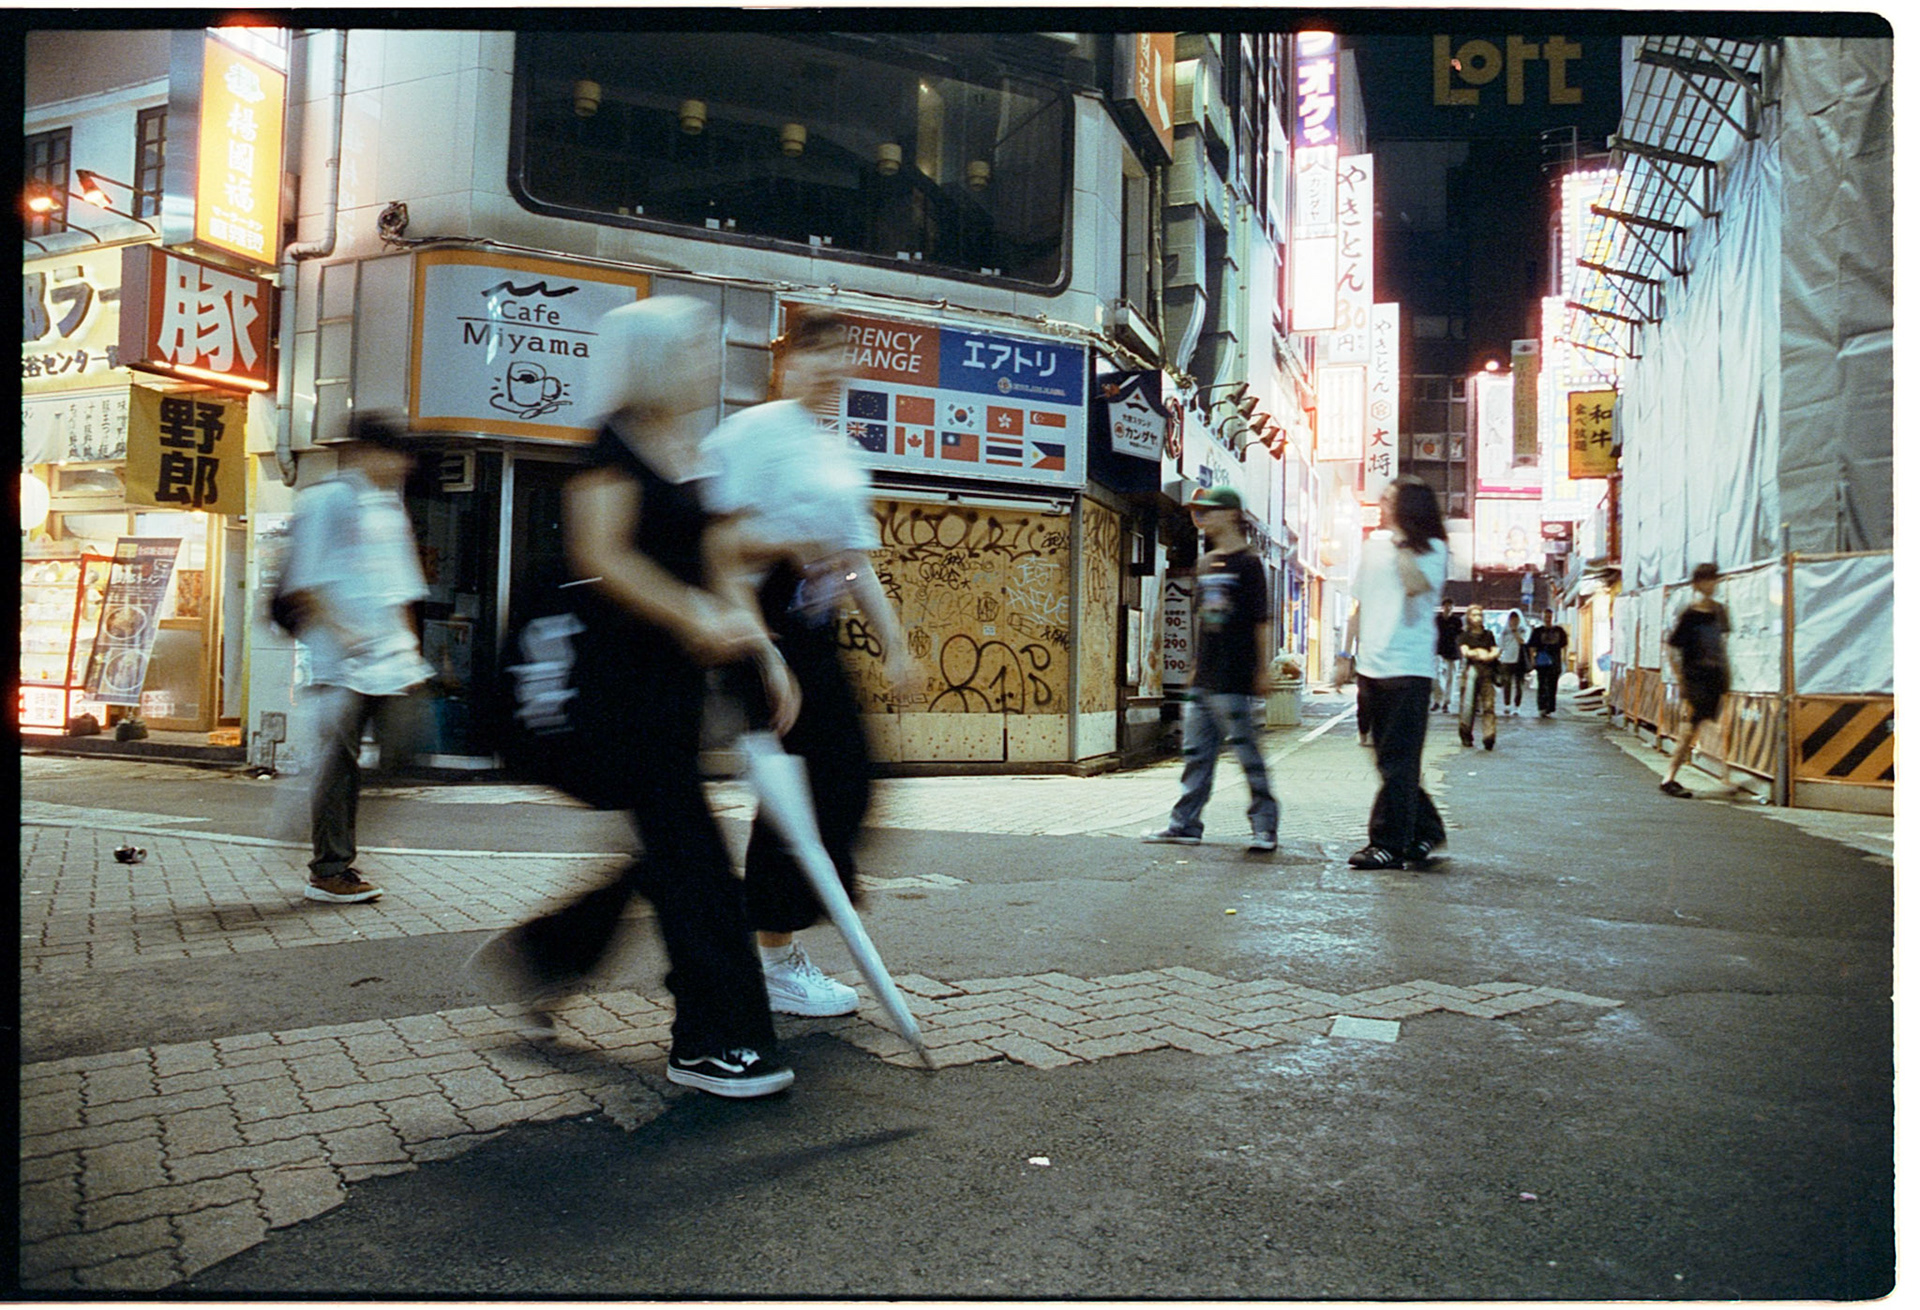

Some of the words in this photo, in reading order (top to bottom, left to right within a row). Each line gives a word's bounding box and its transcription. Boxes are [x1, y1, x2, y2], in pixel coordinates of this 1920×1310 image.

[158, 255, 258, 372] 豚
[500, 300, 560, 325] Cafe
[463, 322, 591, 358] Miyama
[962, 340, 1056, 377] エアトリ
[1589, 404, 1612, 449] 和牛
[154, 397, 225, 508] 野郎
[1368, 428, 1393, 478] 大将
[1163, 639, 1187, 649] 290
